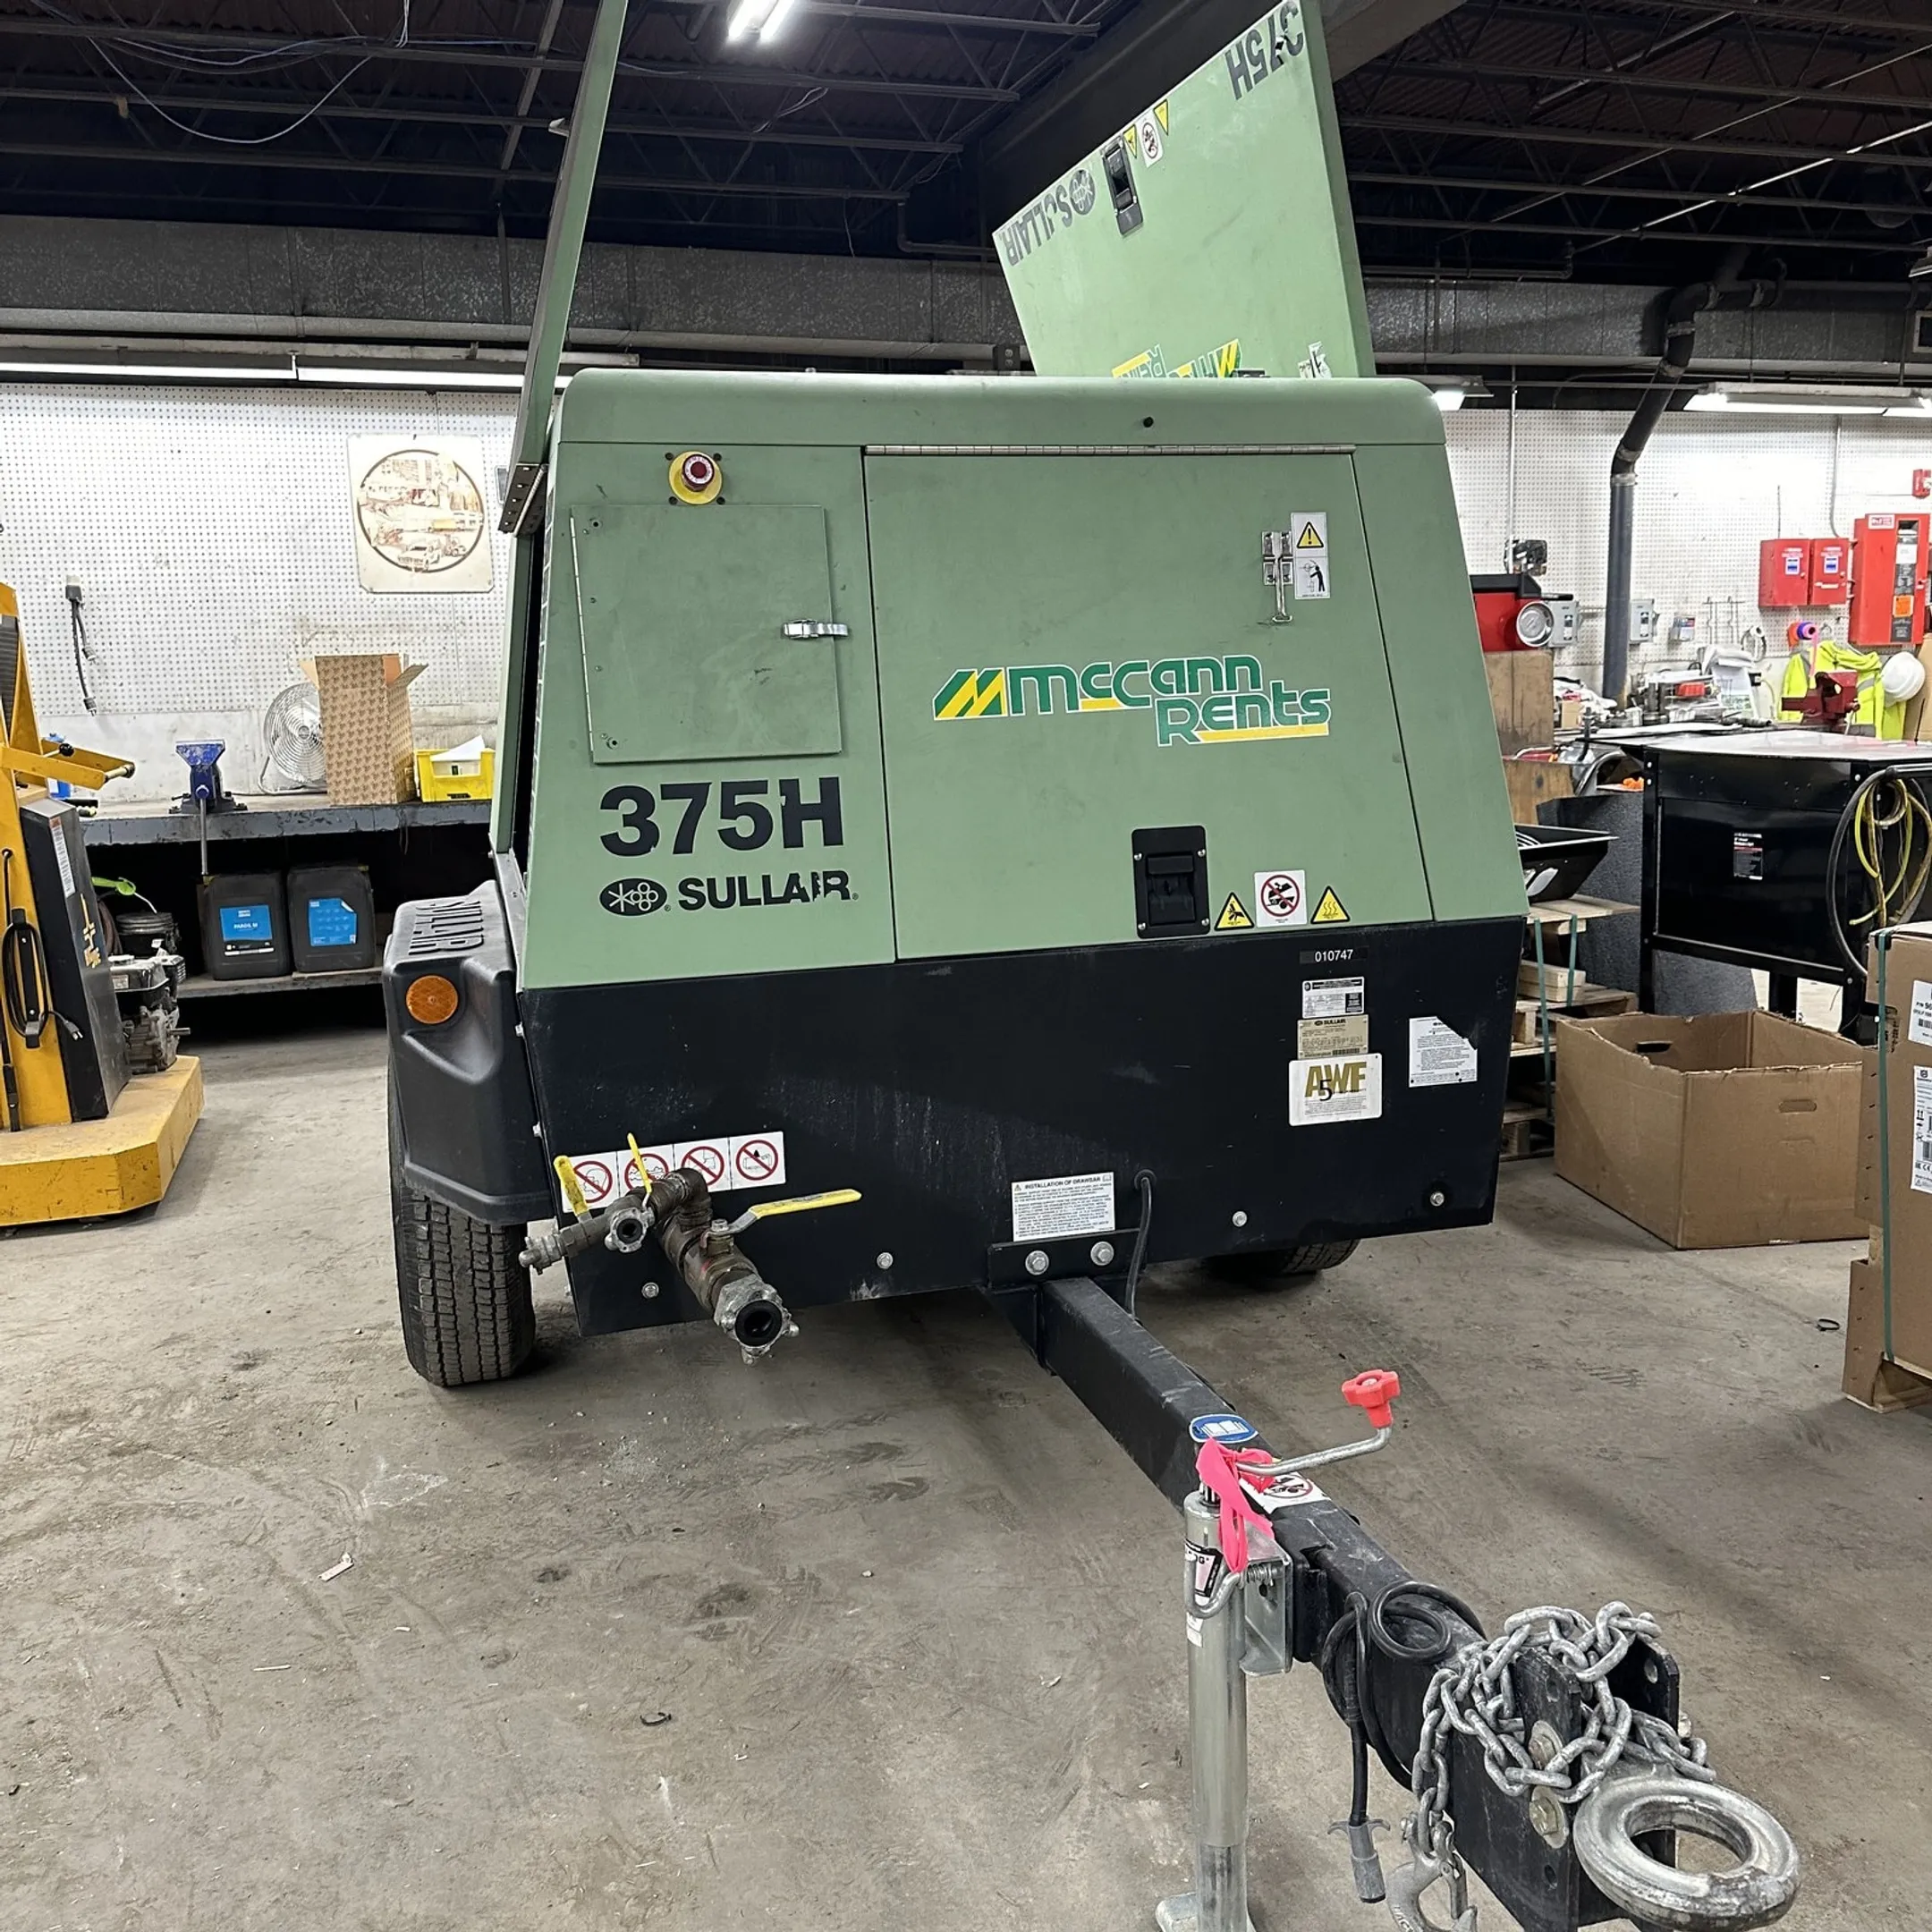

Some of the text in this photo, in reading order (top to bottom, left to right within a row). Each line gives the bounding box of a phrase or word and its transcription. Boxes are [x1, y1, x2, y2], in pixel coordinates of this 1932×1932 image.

[1224, 1, 1304, 100] 375H
[1002, 184, 1072, 266] SULLAIR
[600, 776, 844, 857] 375H
[678, 870, 852, 911] SULLAIR
[1315, 949, 1353, 962] 010747
[1305, 1061, 1367, 1097] AWF
